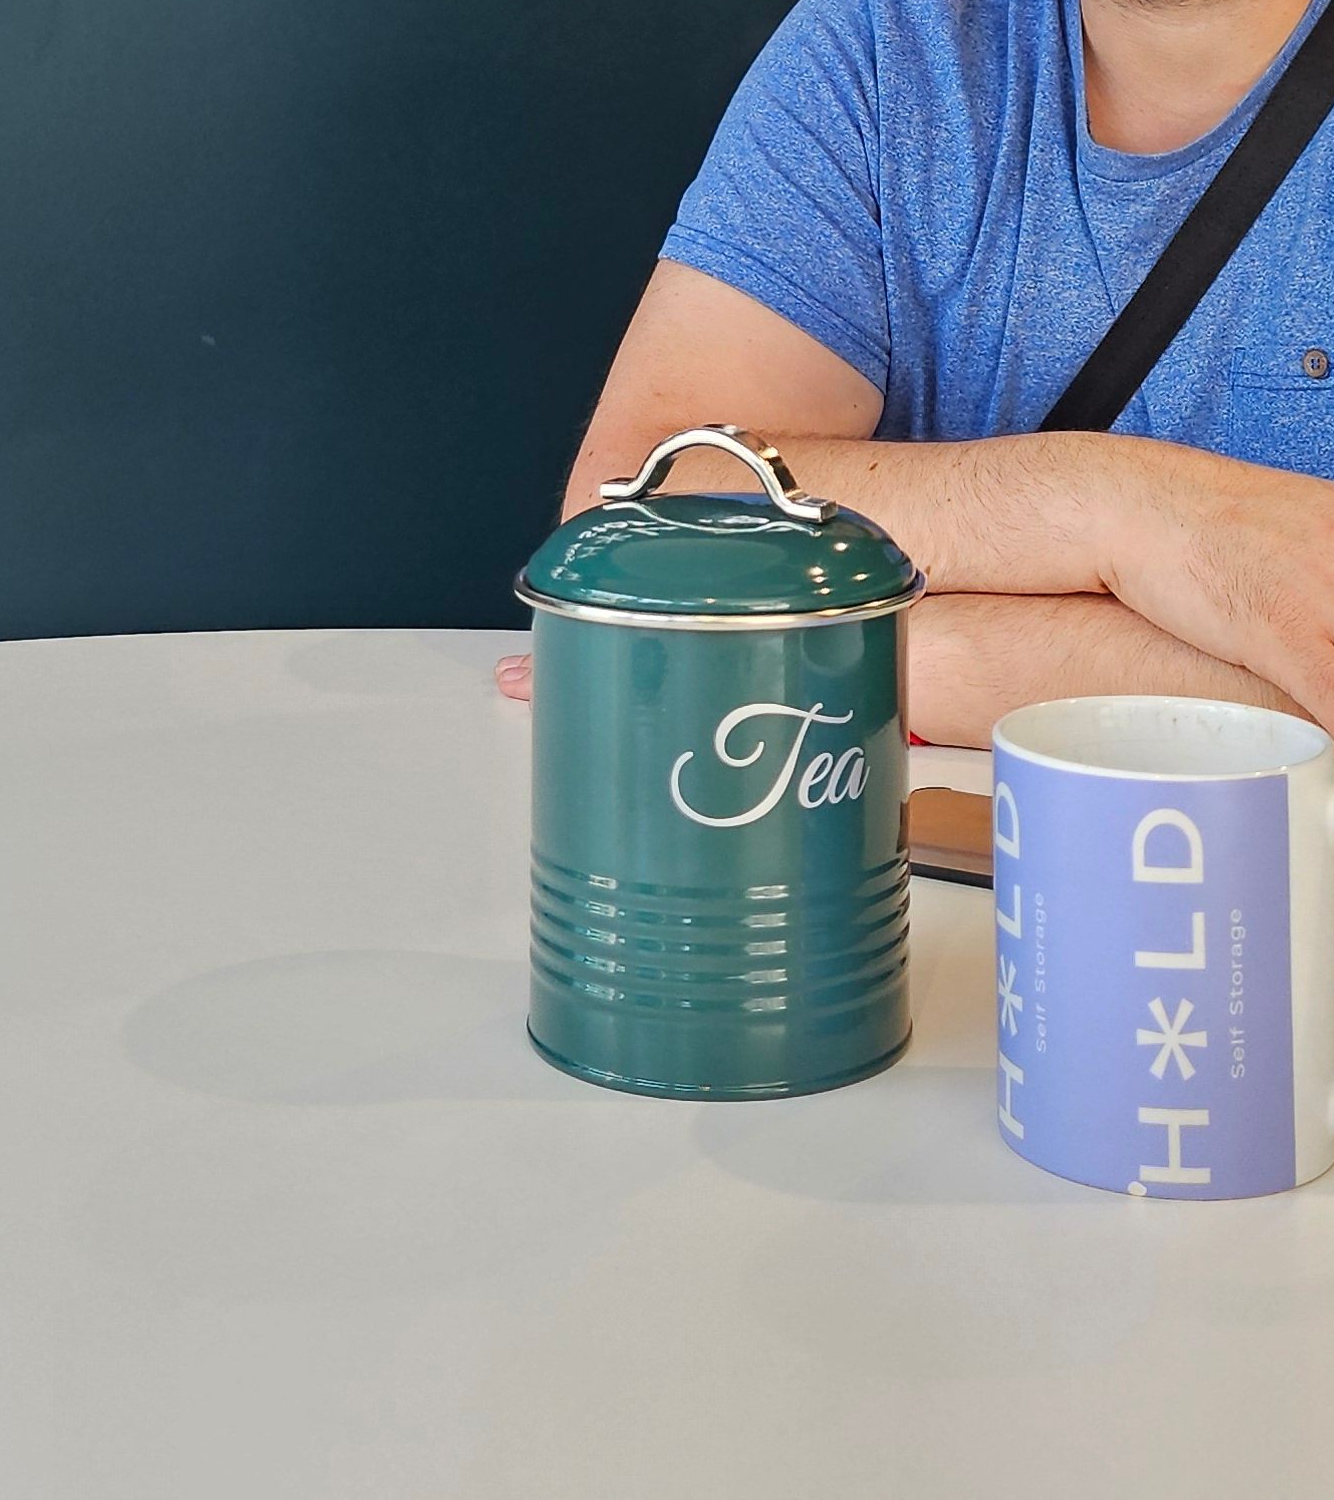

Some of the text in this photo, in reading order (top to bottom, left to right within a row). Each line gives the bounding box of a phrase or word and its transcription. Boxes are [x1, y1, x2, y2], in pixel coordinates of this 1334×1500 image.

[670, 702, 871, 828] Tea
[1034, 891, 1047, 1054] Self Storage
[1229, 908, 1247, 1079] Self Storage
